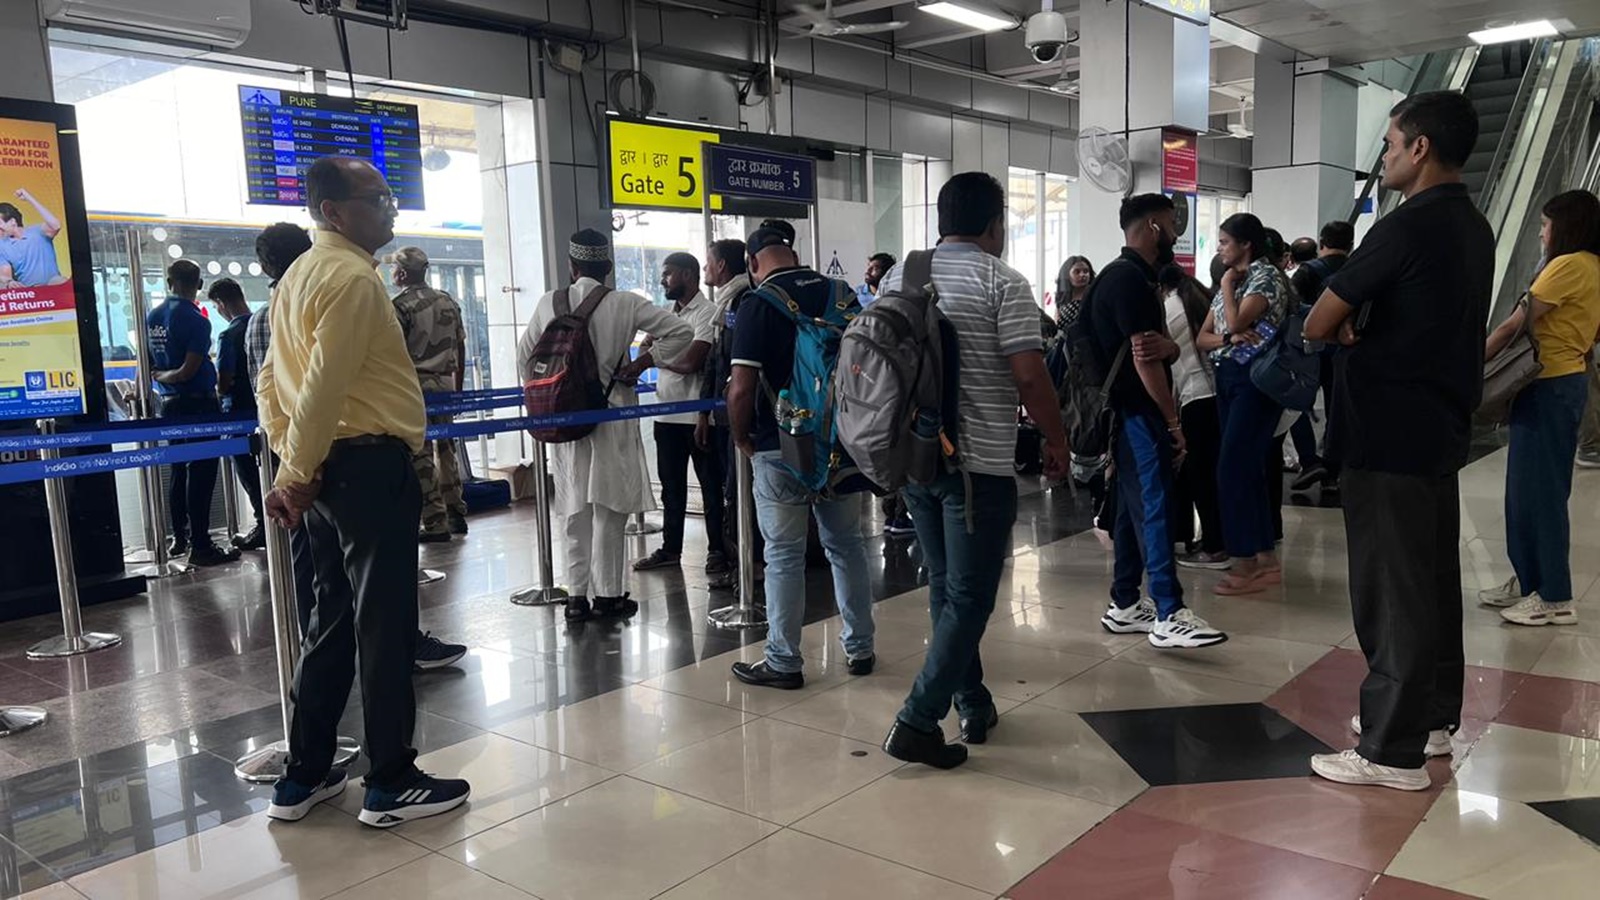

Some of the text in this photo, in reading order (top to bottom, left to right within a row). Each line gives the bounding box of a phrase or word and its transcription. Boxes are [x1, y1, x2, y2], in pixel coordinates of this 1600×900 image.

[289, 95, 317, 108] PUNE
[28, 150, 49, 159] FOR
[619, 150, 636, 166] द्वार
[652, 153, 668, 168] द्वार
[0, 158, 53, 169] EBRATION
[621, 156, 696, 198] Gate 5
[728, 175, 750, 188] GATE
[751, 178, 785, 191] NUMBER
[793, 170, 800, 188] 5
[9, 300, 55, 311] Returns
[49, 371, 75, 388] LIC
[44, 462, 77, 473] IndiGo
